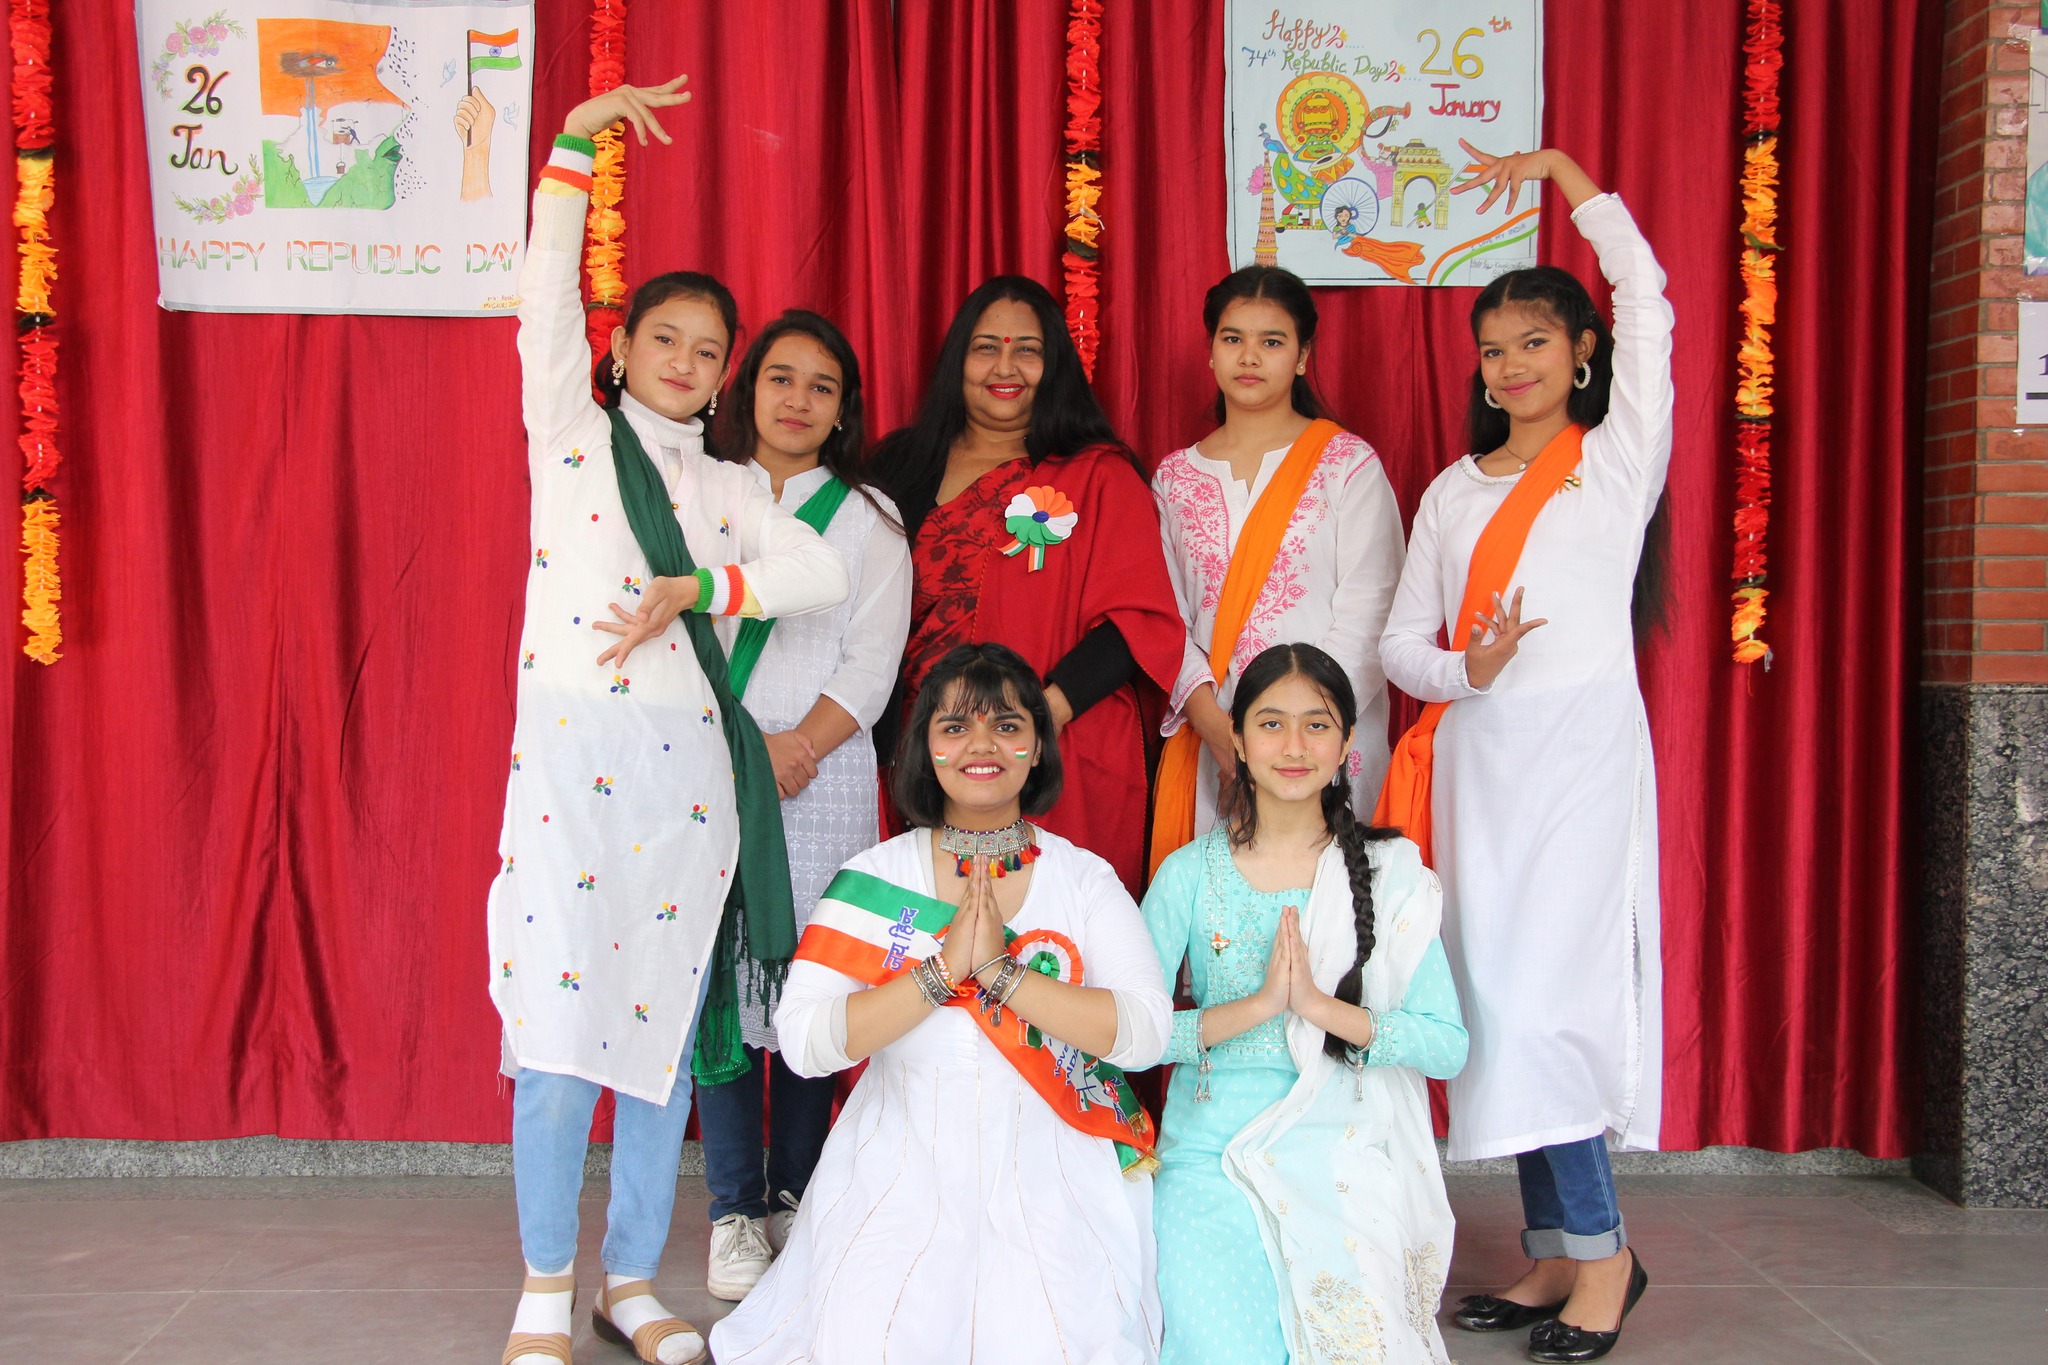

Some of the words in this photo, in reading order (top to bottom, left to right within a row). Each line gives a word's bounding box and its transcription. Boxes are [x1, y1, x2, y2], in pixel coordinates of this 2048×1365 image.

[1262, 9, 1332, 51] Happy
[1280, 49, 1347, 77] Republic
[1353, 55, 1388, 83] Day
[182, 65, 231, 115] 26
[1428, 83, 1501, 123] January
[170, 123, 239, 175] Jan
[159, 237, 266, 272] HAPPY
[286, 240, 441, 275] REPUBLIC
[466, 241, 518, 274] DAY
[882, 941, 910, 971] जय
